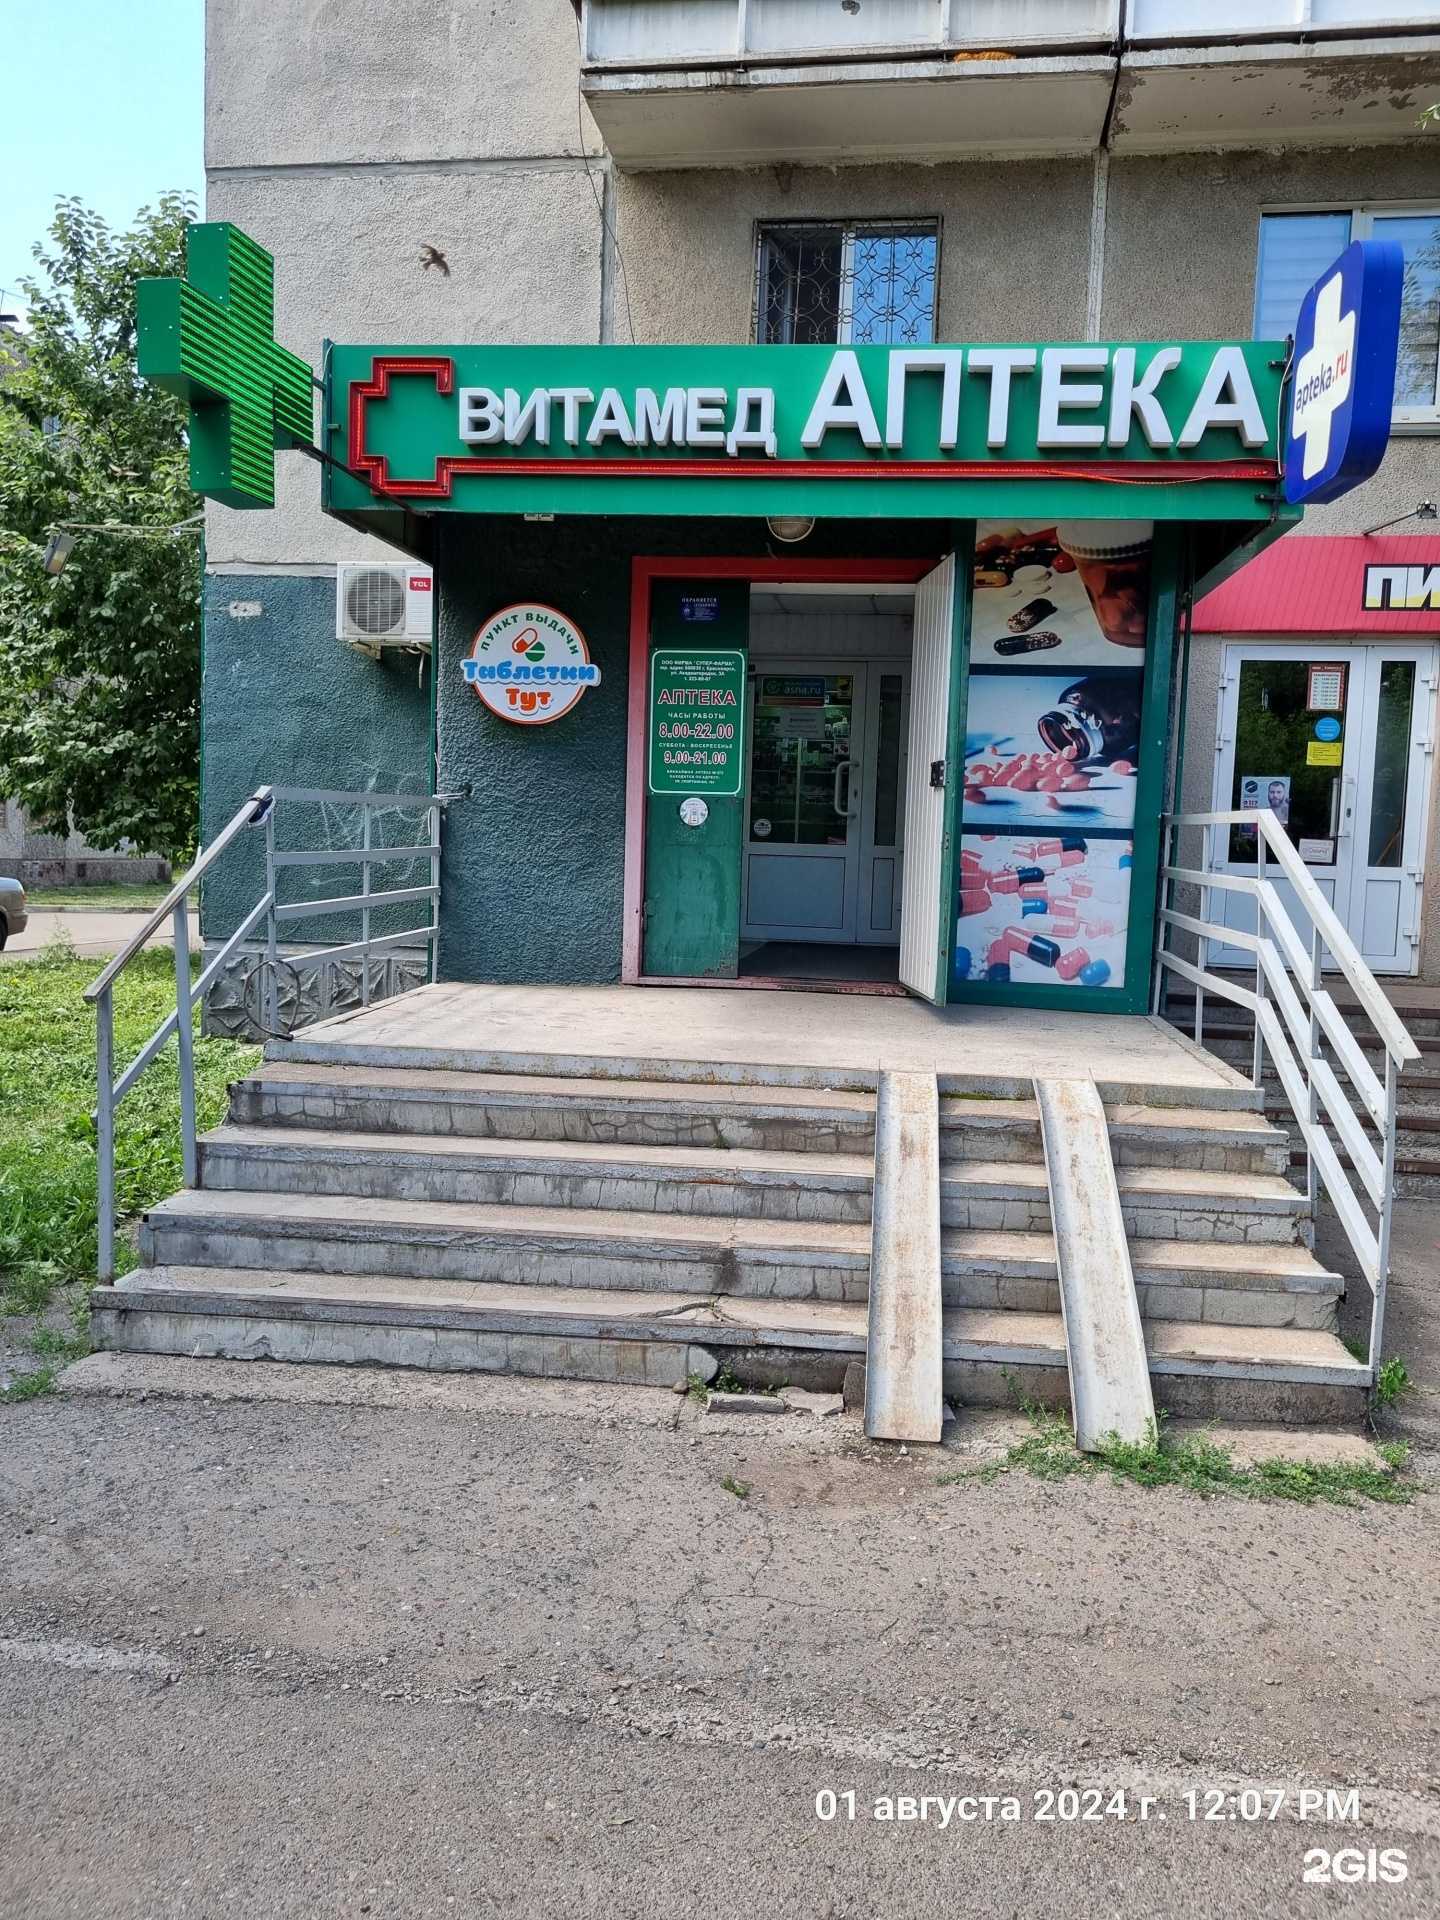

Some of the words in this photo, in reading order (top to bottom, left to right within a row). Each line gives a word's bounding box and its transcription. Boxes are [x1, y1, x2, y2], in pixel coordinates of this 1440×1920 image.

[1295, 350, 1349, 411] apteka.ru
[458, 387, 778, 459] ВИТАМЕД
[799, 347, 1269, 450] АПТЕКА
[480, 614, 519, 651] ПУНКТ
[525, 612, 579, 655] ВЫДАЧИ
[462, 660, 596, 681] Таблетки
[505, 687, 552, 712] Тут
[658, 689, 736, 706] АПТЕКА
[783, 687, 821, 696] asna.ru
[692, 712, 726, 720] РАБОТЫ
[659, 722, 734, 739] 8.00-22.00
[663, 751, 727, 765] 9.00-21.00
